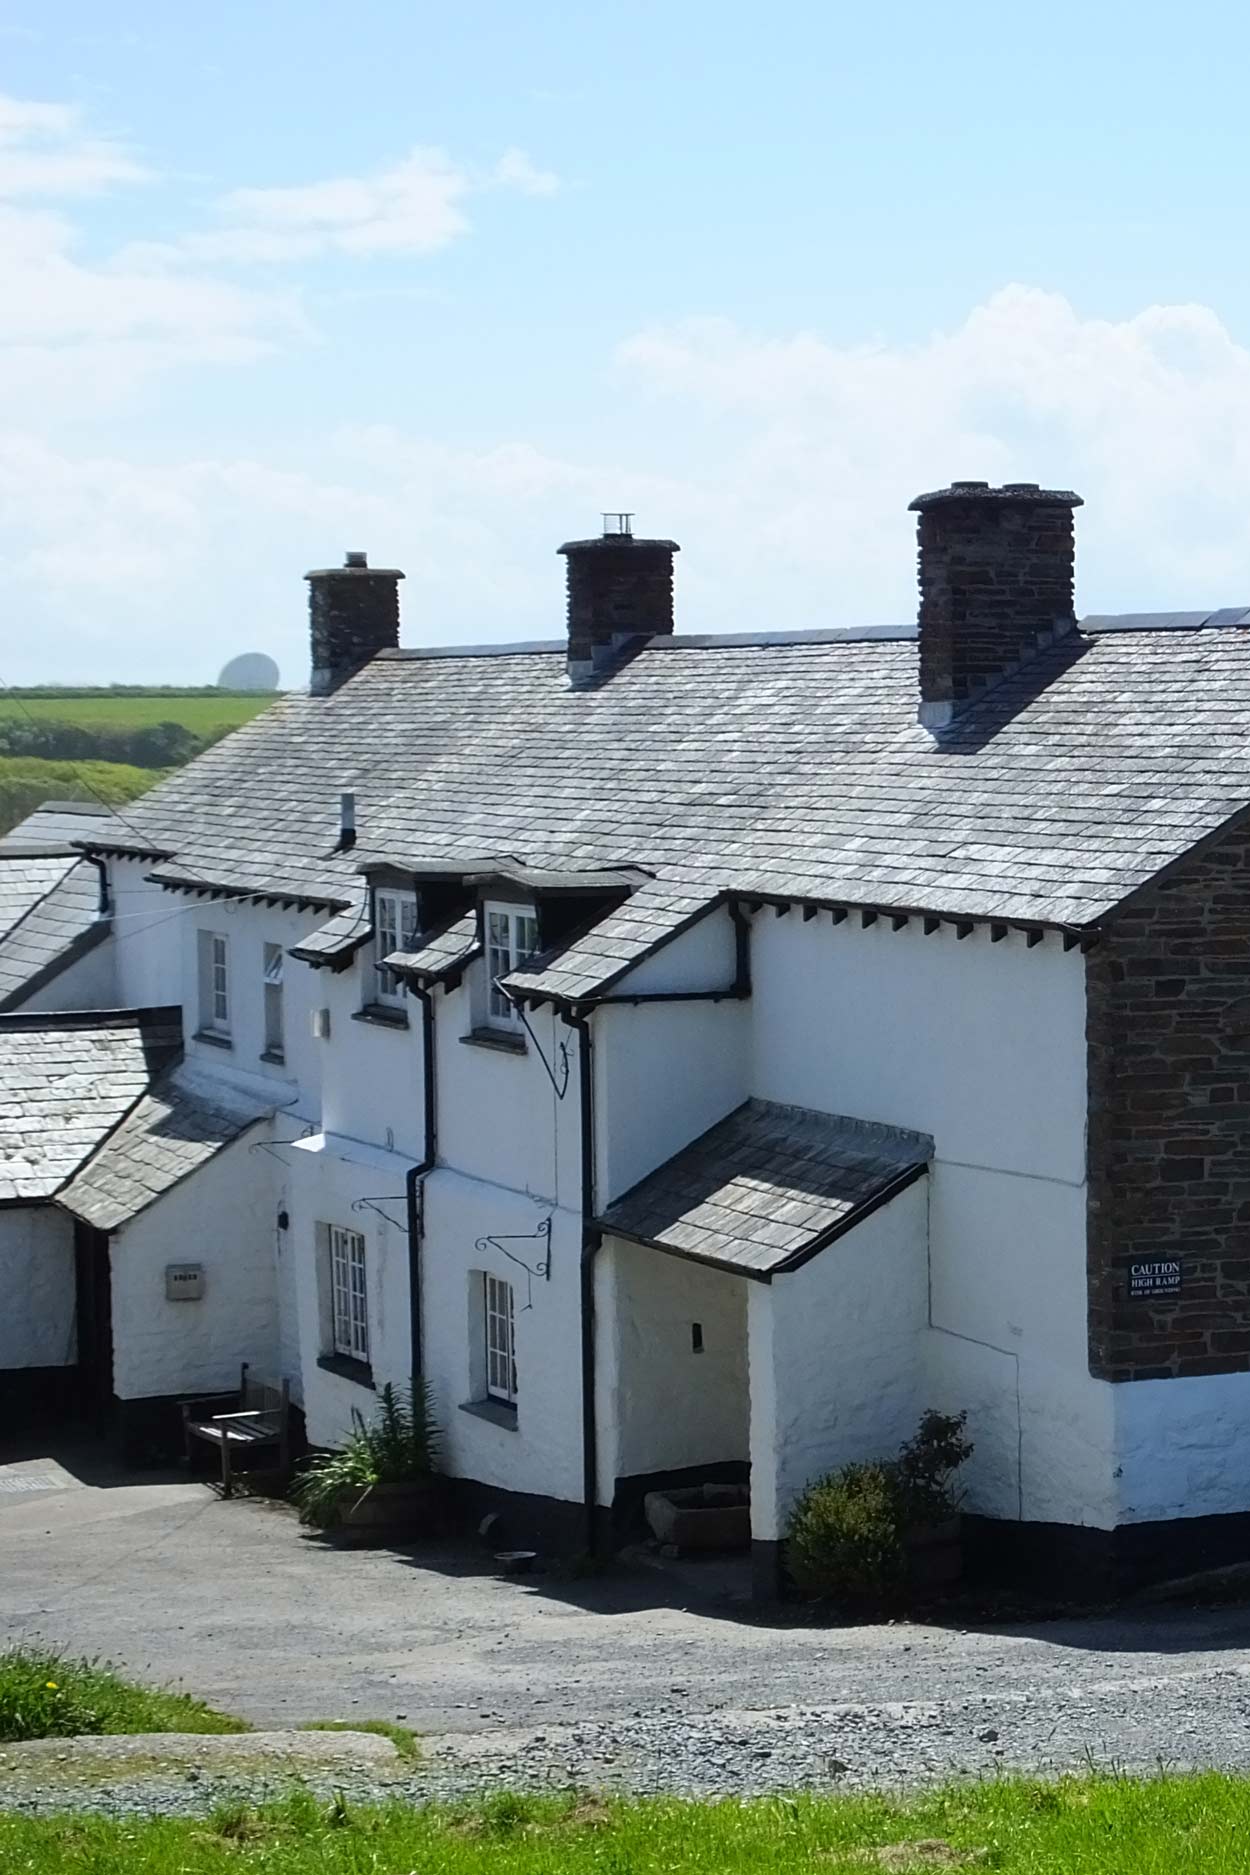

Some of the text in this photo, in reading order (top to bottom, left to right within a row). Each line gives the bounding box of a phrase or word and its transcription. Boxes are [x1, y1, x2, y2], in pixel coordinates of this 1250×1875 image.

[1131, 1262, 1180, 1275] CAUTION
[1131, 1276, 1181, 1287] HIGH RAMP
